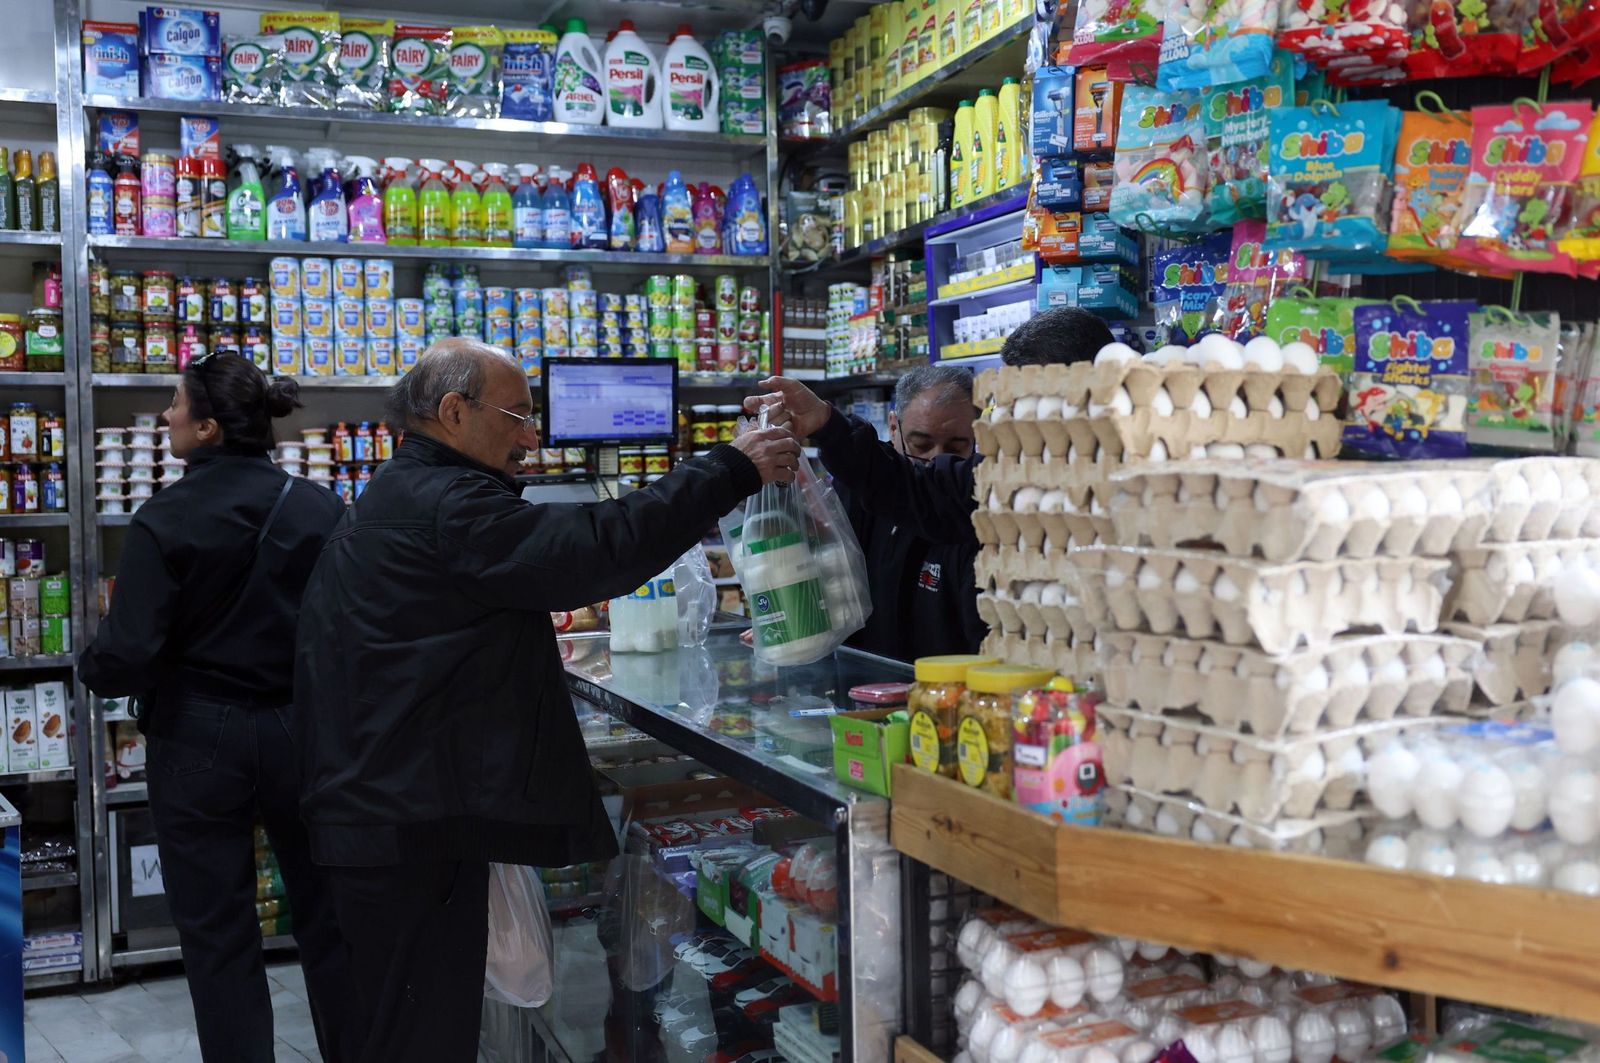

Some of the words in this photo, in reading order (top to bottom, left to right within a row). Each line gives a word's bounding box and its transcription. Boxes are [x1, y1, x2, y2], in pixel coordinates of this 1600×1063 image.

[166, 28, 201, 44] Calgon
[168, 72, 203, 88] Calgon
[609, 68, 643, 80] Persil
[670, 72, 704, 84] Persil
[565, 92, 595, 102] ARIEL
[1279, 130, 1365, 160] Shiba
[1408, 139, 1471, 166] Shib
[1483, 135, 1566, 166] Shiba
[1182, 300, 1205, 312] Mix
[1368, 330, 1455, 362] Shiba
